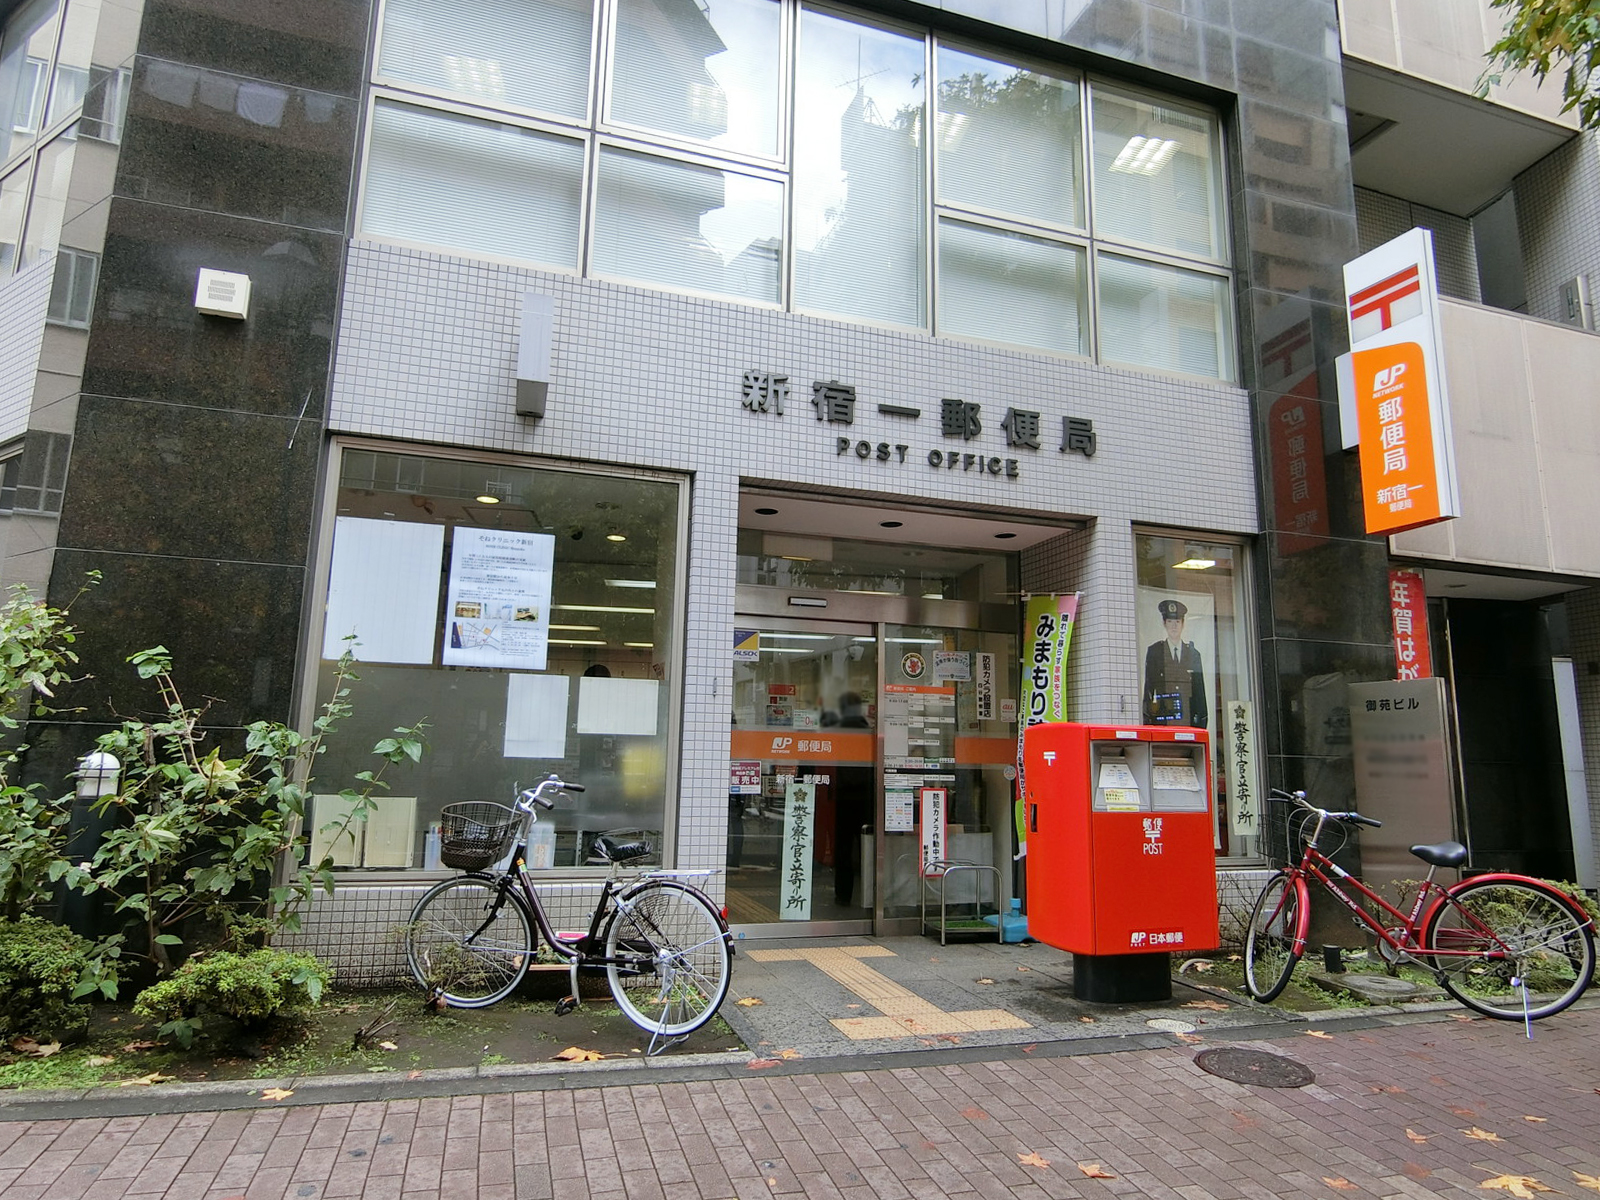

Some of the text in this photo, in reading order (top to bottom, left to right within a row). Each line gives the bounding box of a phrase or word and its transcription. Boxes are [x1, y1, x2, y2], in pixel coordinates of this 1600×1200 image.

[742, 368, 1098, 457] 新宿一郵便局
[1378, 396, 1407, 476] 郵便局
[836, 436, 1020, 478] POST OFFICE
[1376, 483, 1424, 505] 新宿一
[1365, 698, 1420, 712] 御苑ビル
[797, 740, 832, 753] 郵便局
[731, 776, 760, 785] 販売中
[775, 774, 831, 785] 新宿一郵便局
[1142, 817, 1163, 831] 郵便
[1142, 843, 1163, 855] POST
[1149, 931, 1184, 945] 日本郵便
